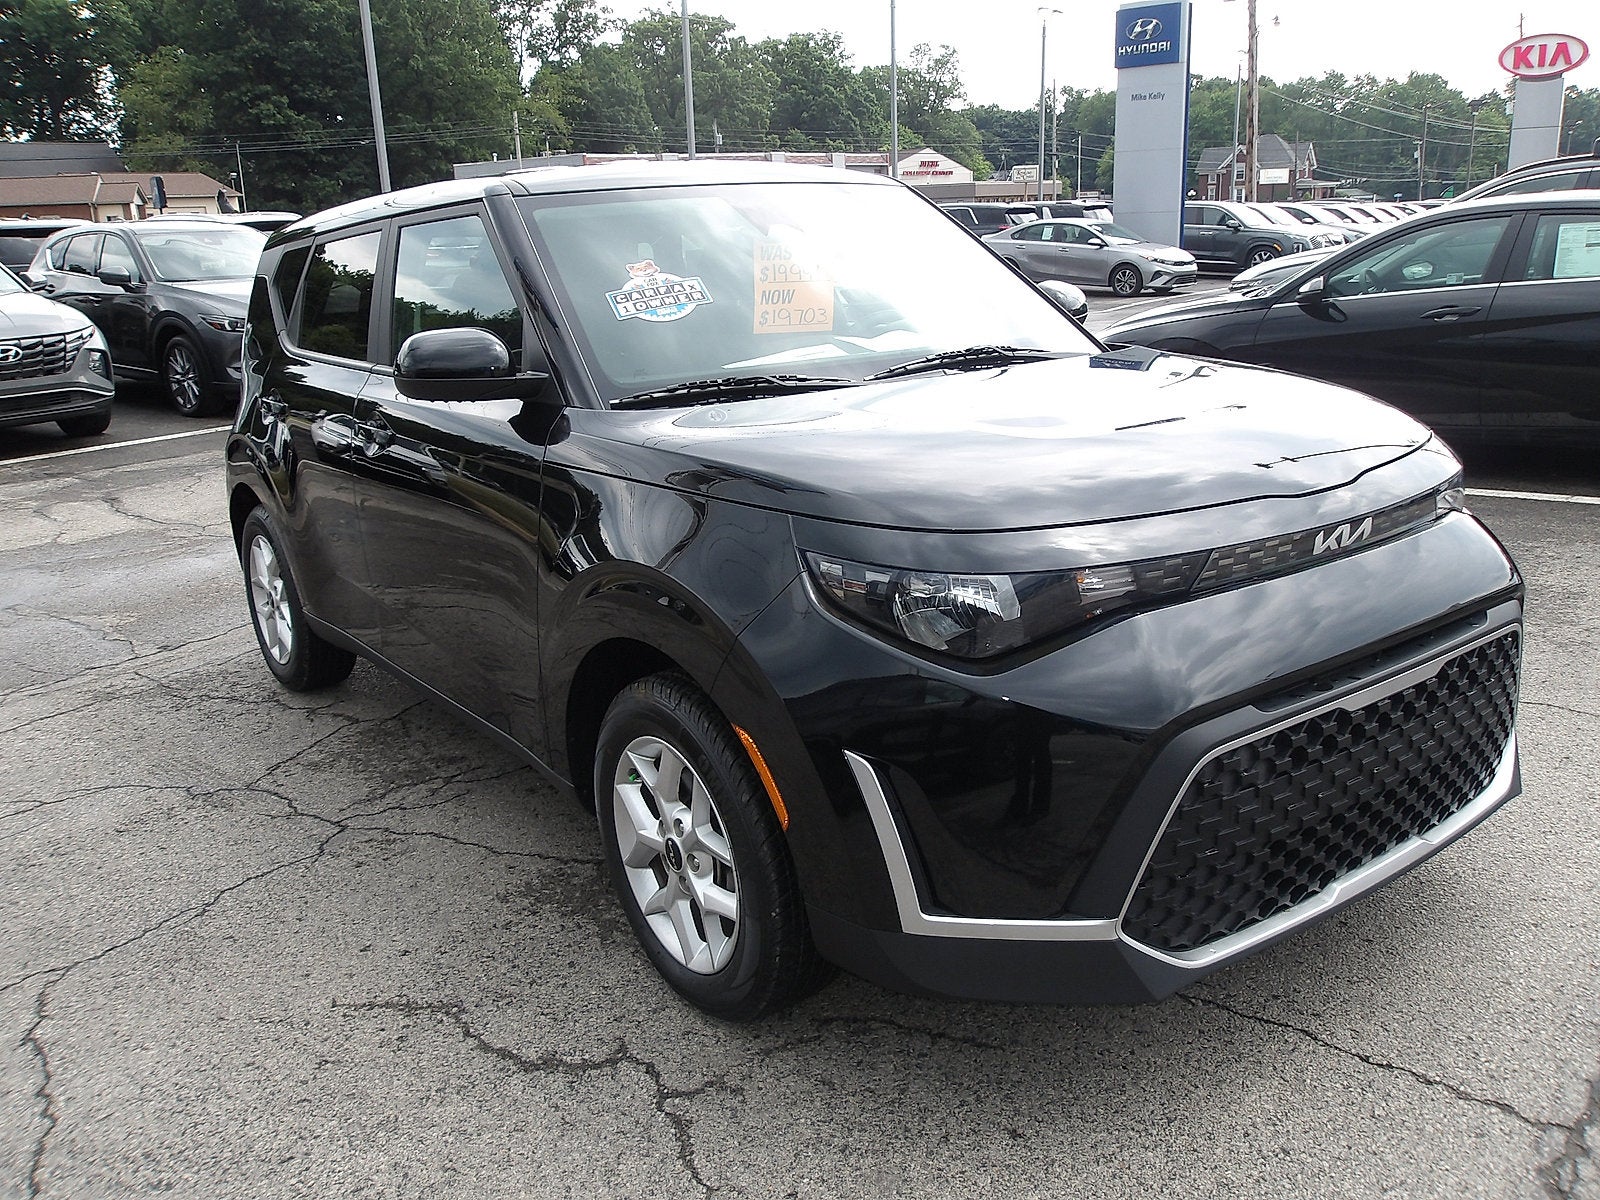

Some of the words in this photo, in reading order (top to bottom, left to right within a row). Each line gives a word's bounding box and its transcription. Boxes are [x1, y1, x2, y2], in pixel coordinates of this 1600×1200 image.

[1118, 41, 1171, 56] HYUNDAI
[1513, 42, 1572, 69] KIA
[1148, 92, 1165, 100] Kelly
[760, 245, 793, 261] WAS
[612, 283, 697, 304] CARFAX
[633, 290, 706, 312] OWNER
[760, 289, 796, 305] NOW
[759, 307, 828, 327] $19703
[1313, 516, 1373, 555] KIA
